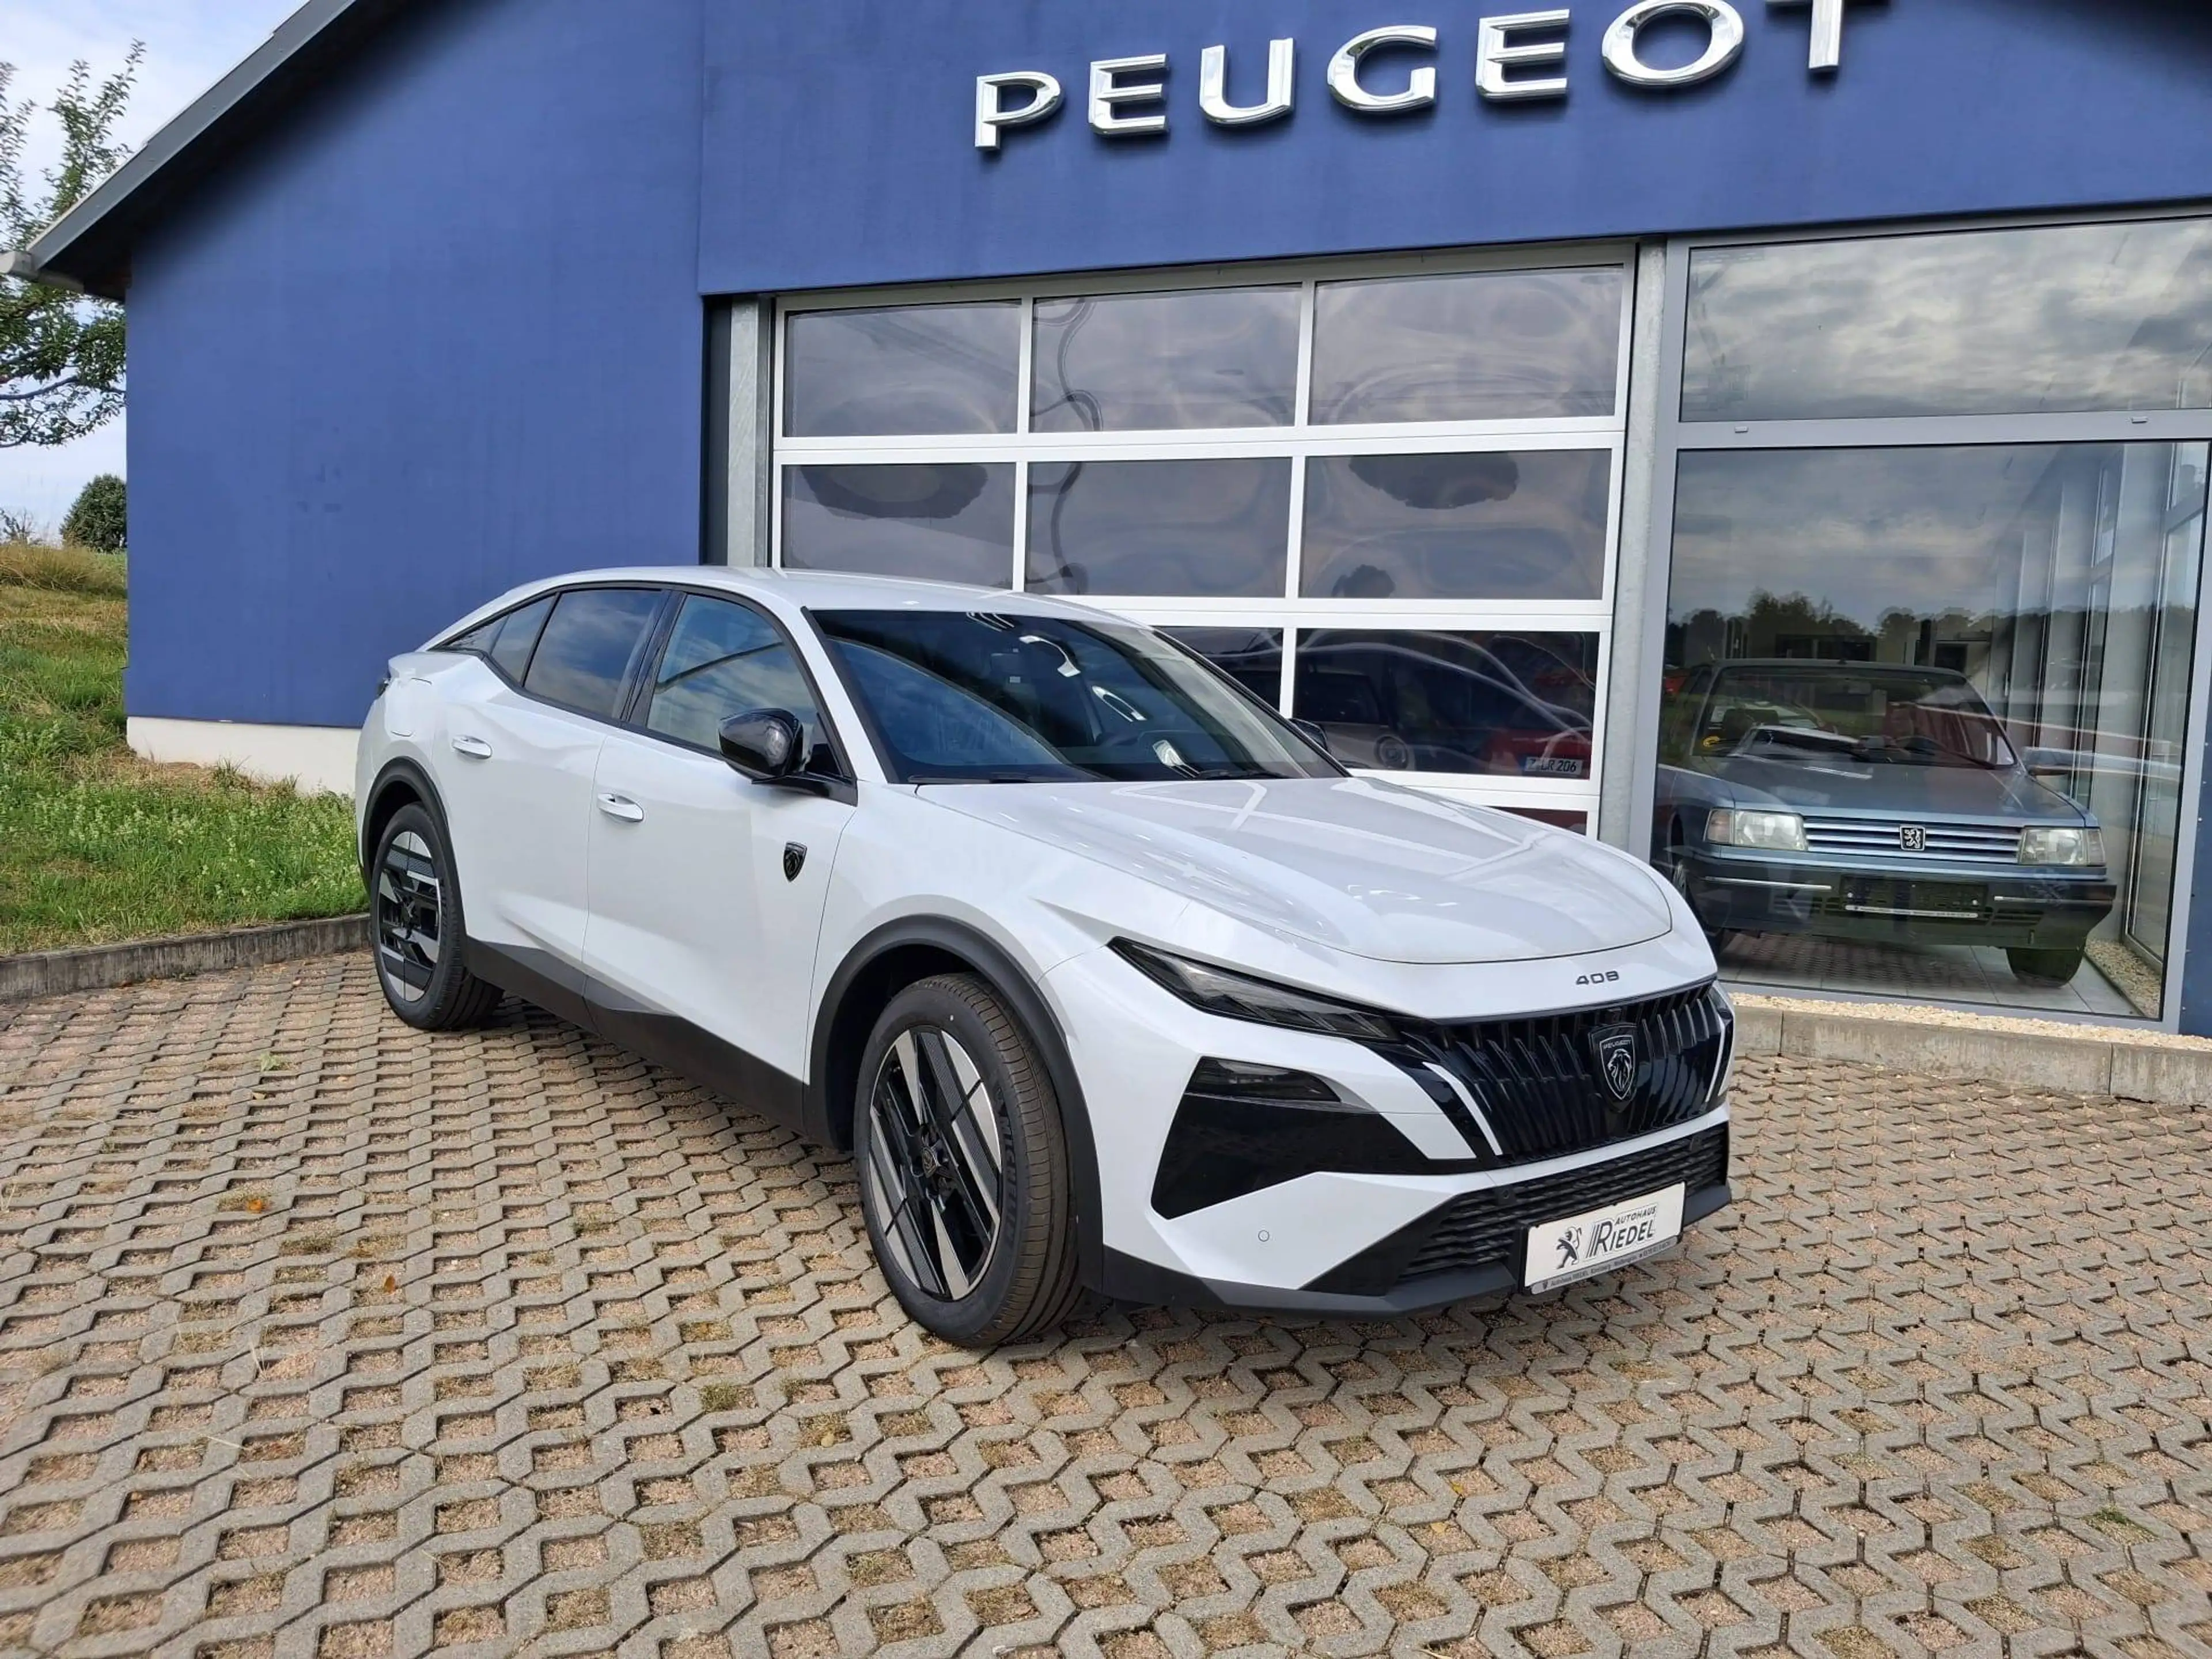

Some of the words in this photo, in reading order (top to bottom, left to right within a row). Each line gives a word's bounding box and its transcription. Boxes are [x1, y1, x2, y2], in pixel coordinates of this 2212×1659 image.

[974, 0, 1843, 150] PEUGEOT
[1556, 760, 1577, 772] 206
[1575, 970, 1619, 985] 408
[1615, 1206, 1657, 1225] AUTOHAUS
[1593, 1219, 1653, 1256] RIEDEL
